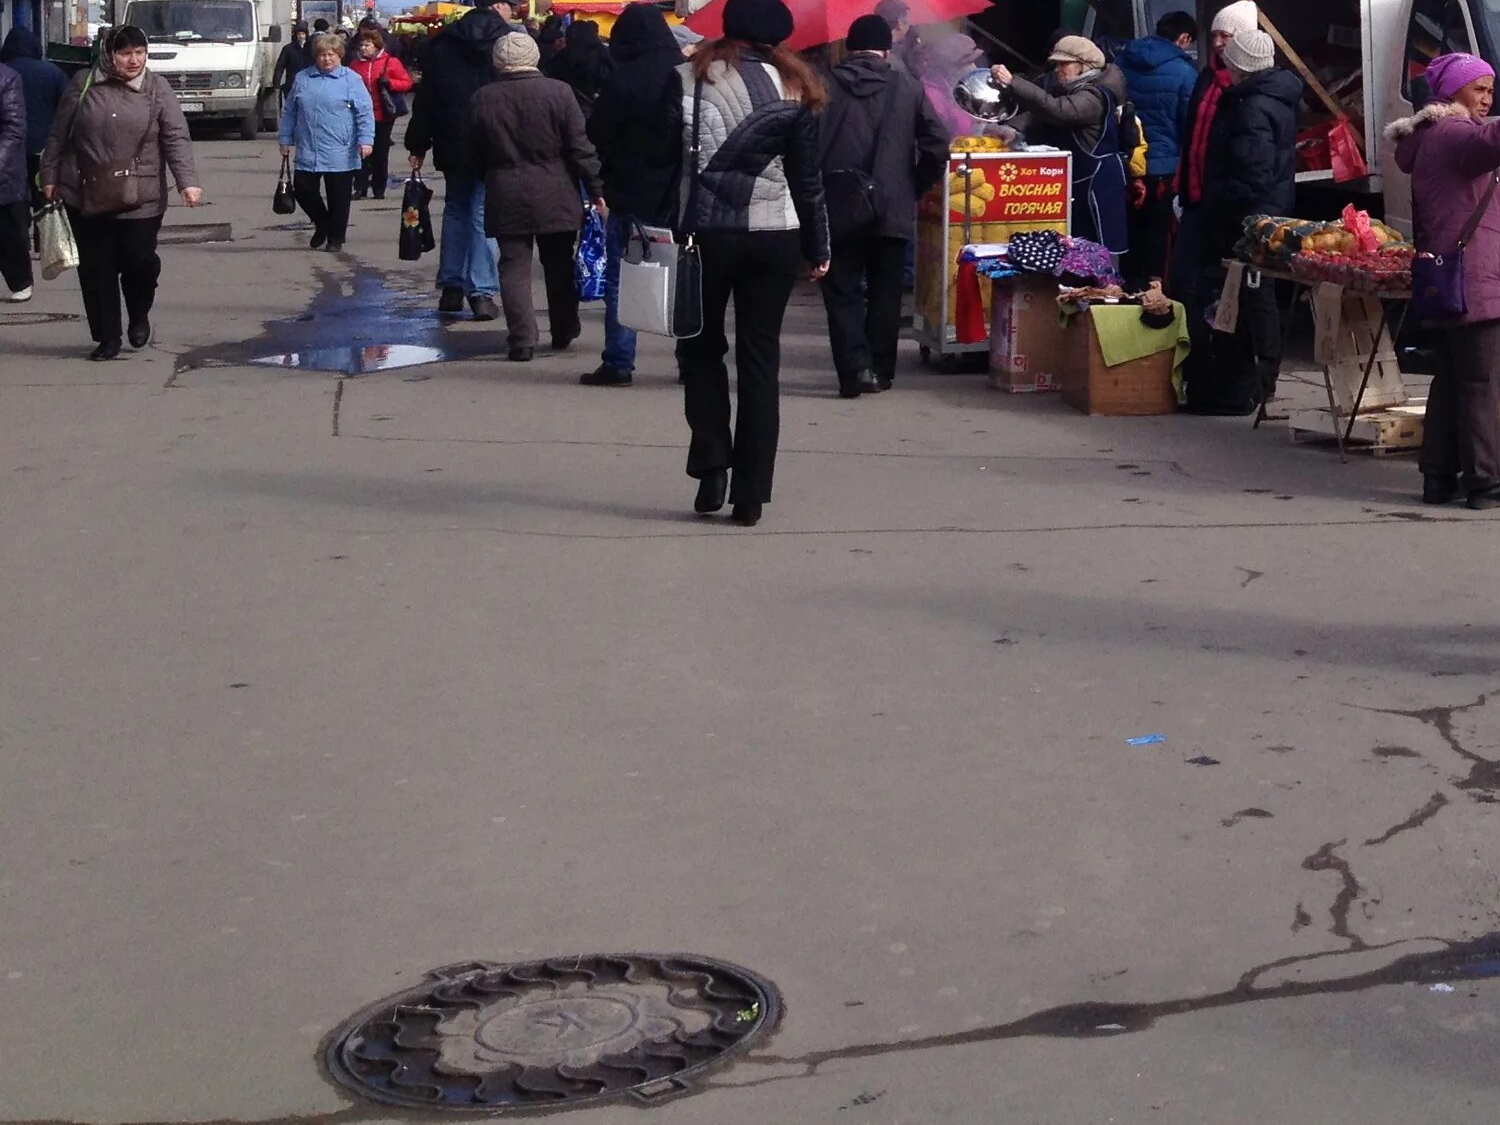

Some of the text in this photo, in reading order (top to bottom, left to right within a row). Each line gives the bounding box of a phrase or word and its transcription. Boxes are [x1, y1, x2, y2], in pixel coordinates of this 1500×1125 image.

[1020, 167, 1063, 177] Хот Корн
[999, 183, 1062, 197] ВКУСНАЯ
[1004, 201, 1063, 215] ГОРЯЧАЯ
